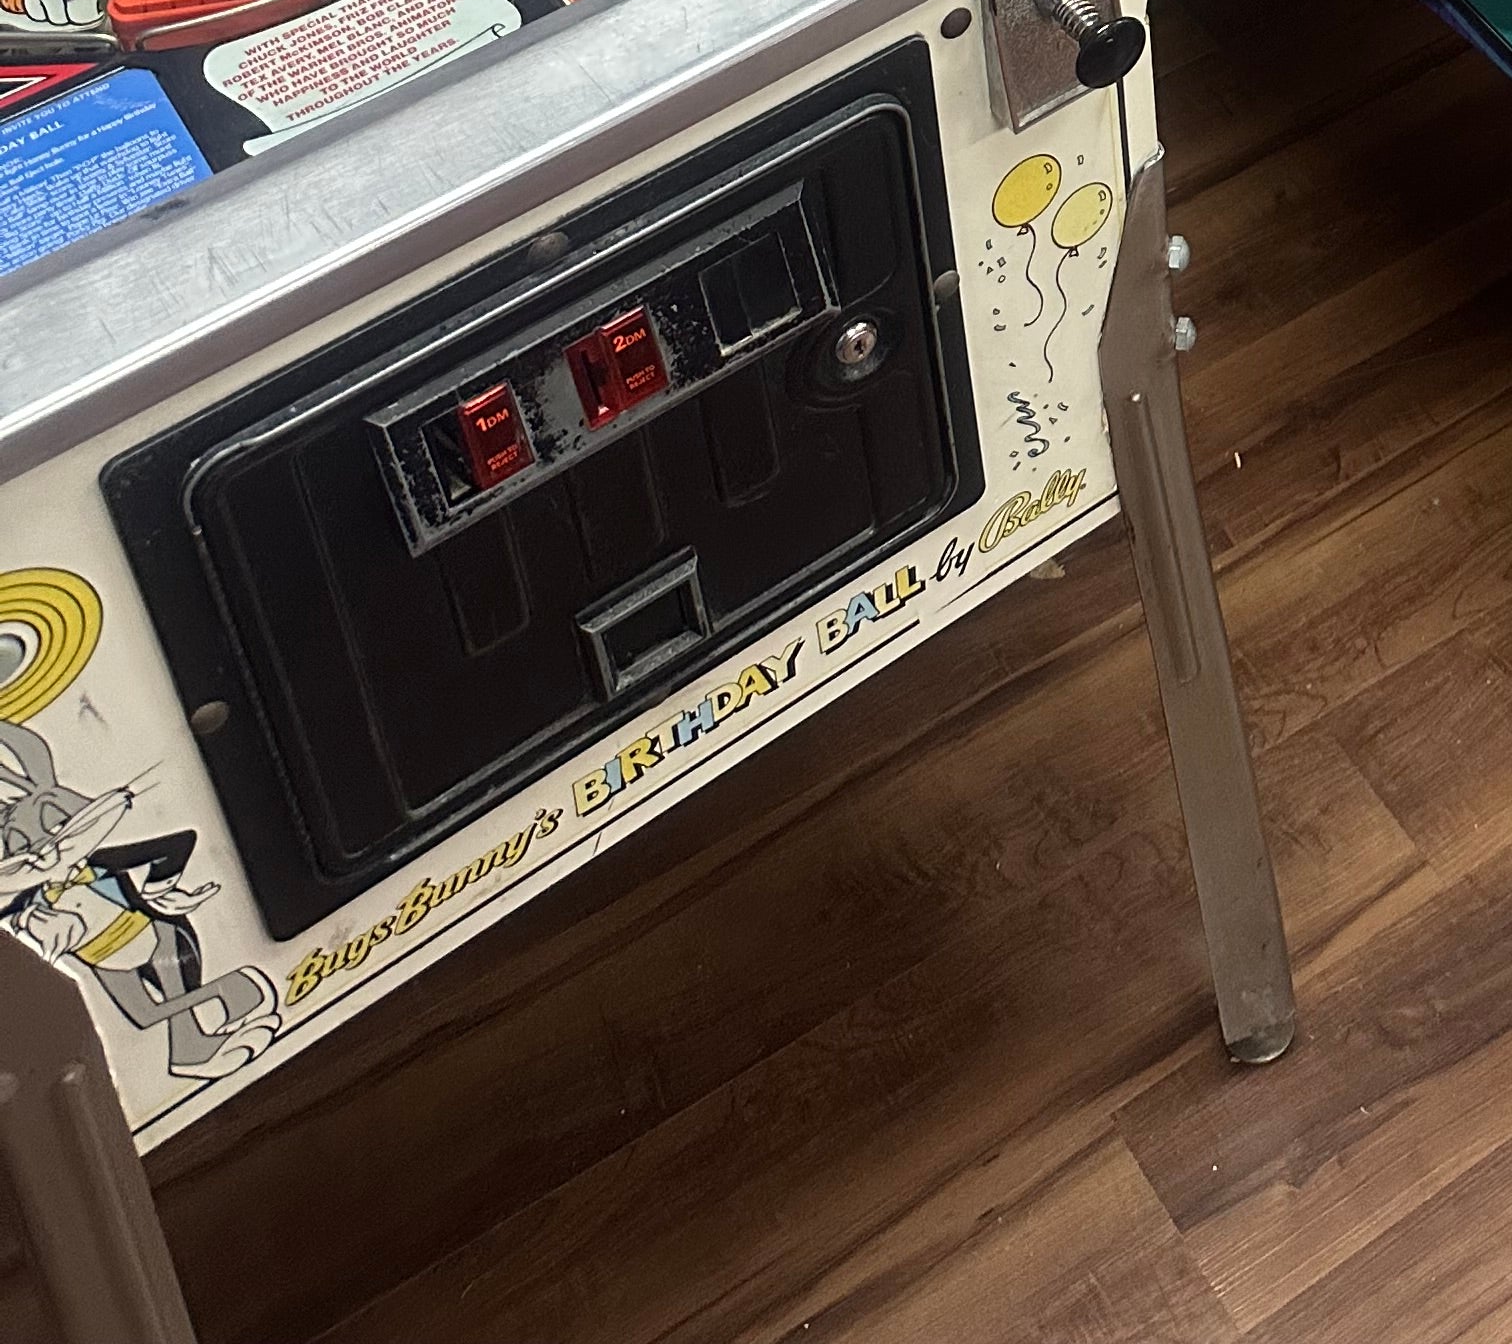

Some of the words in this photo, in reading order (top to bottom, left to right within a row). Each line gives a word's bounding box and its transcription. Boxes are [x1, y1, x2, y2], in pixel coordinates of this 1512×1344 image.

[222, 58, 278, 88] ROBERT
[356, 10, 385, 27] BOB
[238, 44, 287, 70] CHUCK
[338, 6, 369, 25] FRIZ
[240, 73, 268, 90] TEX
[316, 38, 345, 55] MEL
[396, 3, 424, 19] AND
[244, 36, 281, 57] WITH
[282, 12, 337, 40] SPECIAL
[255, 85, 290, 104] WHO
[291, 67, 328, 87] HAVE
[329, 35, 395, 70] BROUGHT
[396, 25, 416, 40] SO
[416, 6, 458, 29] MUCH
[272, 66, 350, 108] HAPPINESS
[351, 52, 380, 71] AND
[381, 19, 453, 57] LAUGHTER
[237, 88, 255, 102] OF
[256, 75, 286, 93] THE
[286, 47, 347, 79] WARNER
[285, 73, 382, 123] THROUGHOUT
[382, 58, 412, 78] THE
[412, 37, 460, 62] YEARS.
[319, 82, 340, 96] TO
[339, 67, 369, 87] THE
[369, 45, 418, 72] WORLD
[1, 117, 33, 135] INVITE
[33, 106, 56, 121] YOU
[57, 99, 72, 111] TO
[72, 82, 111, 104] ATTEND
[29, 120, 66, 141] BALL
[612, 327, 647, 353] 2DM
[475, 407, 510, 433] 1DM
[284, 907, 397, 1009] Bugs
[394, 806, 564, 937] Bunny's
[573, 636, 806, 819] BIRTHDAY
[816, 564, 925, 656] BALL
[928, 538, 976, 585] by
[976, 469, 1086, 559] Bally
